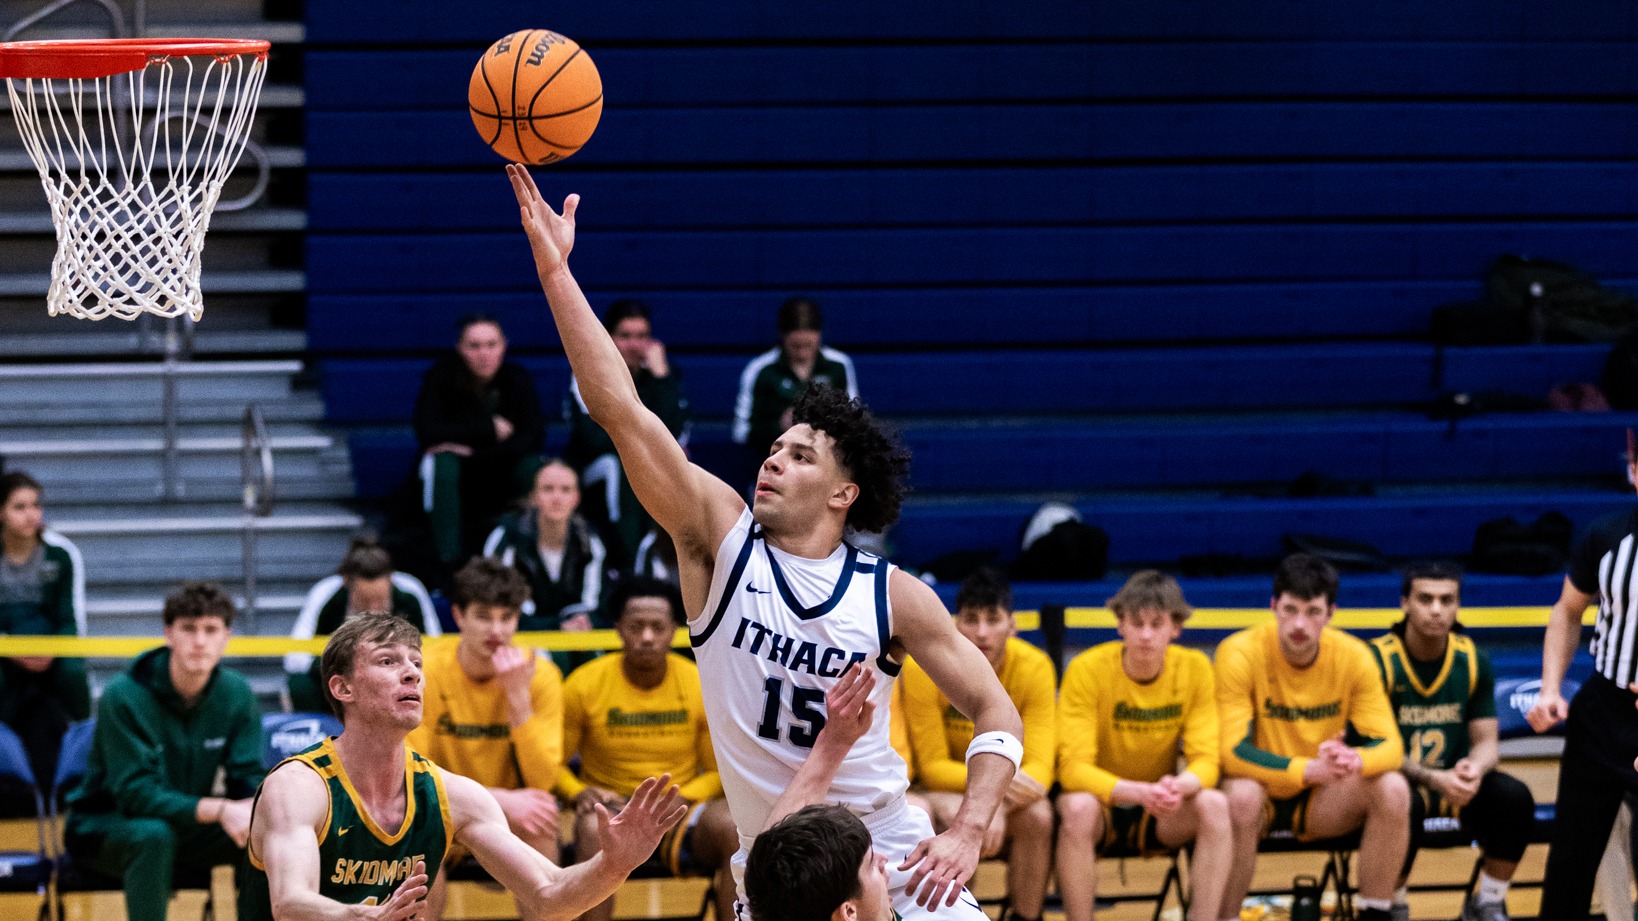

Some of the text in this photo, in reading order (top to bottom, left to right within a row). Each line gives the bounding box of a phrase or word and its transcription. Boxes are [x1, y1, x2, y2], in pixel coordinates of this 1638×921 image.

[731, 616, 867, 678] ITHACA
[756, 674, 827, 750] 15
[1409, 729, 1446, 768] 12
